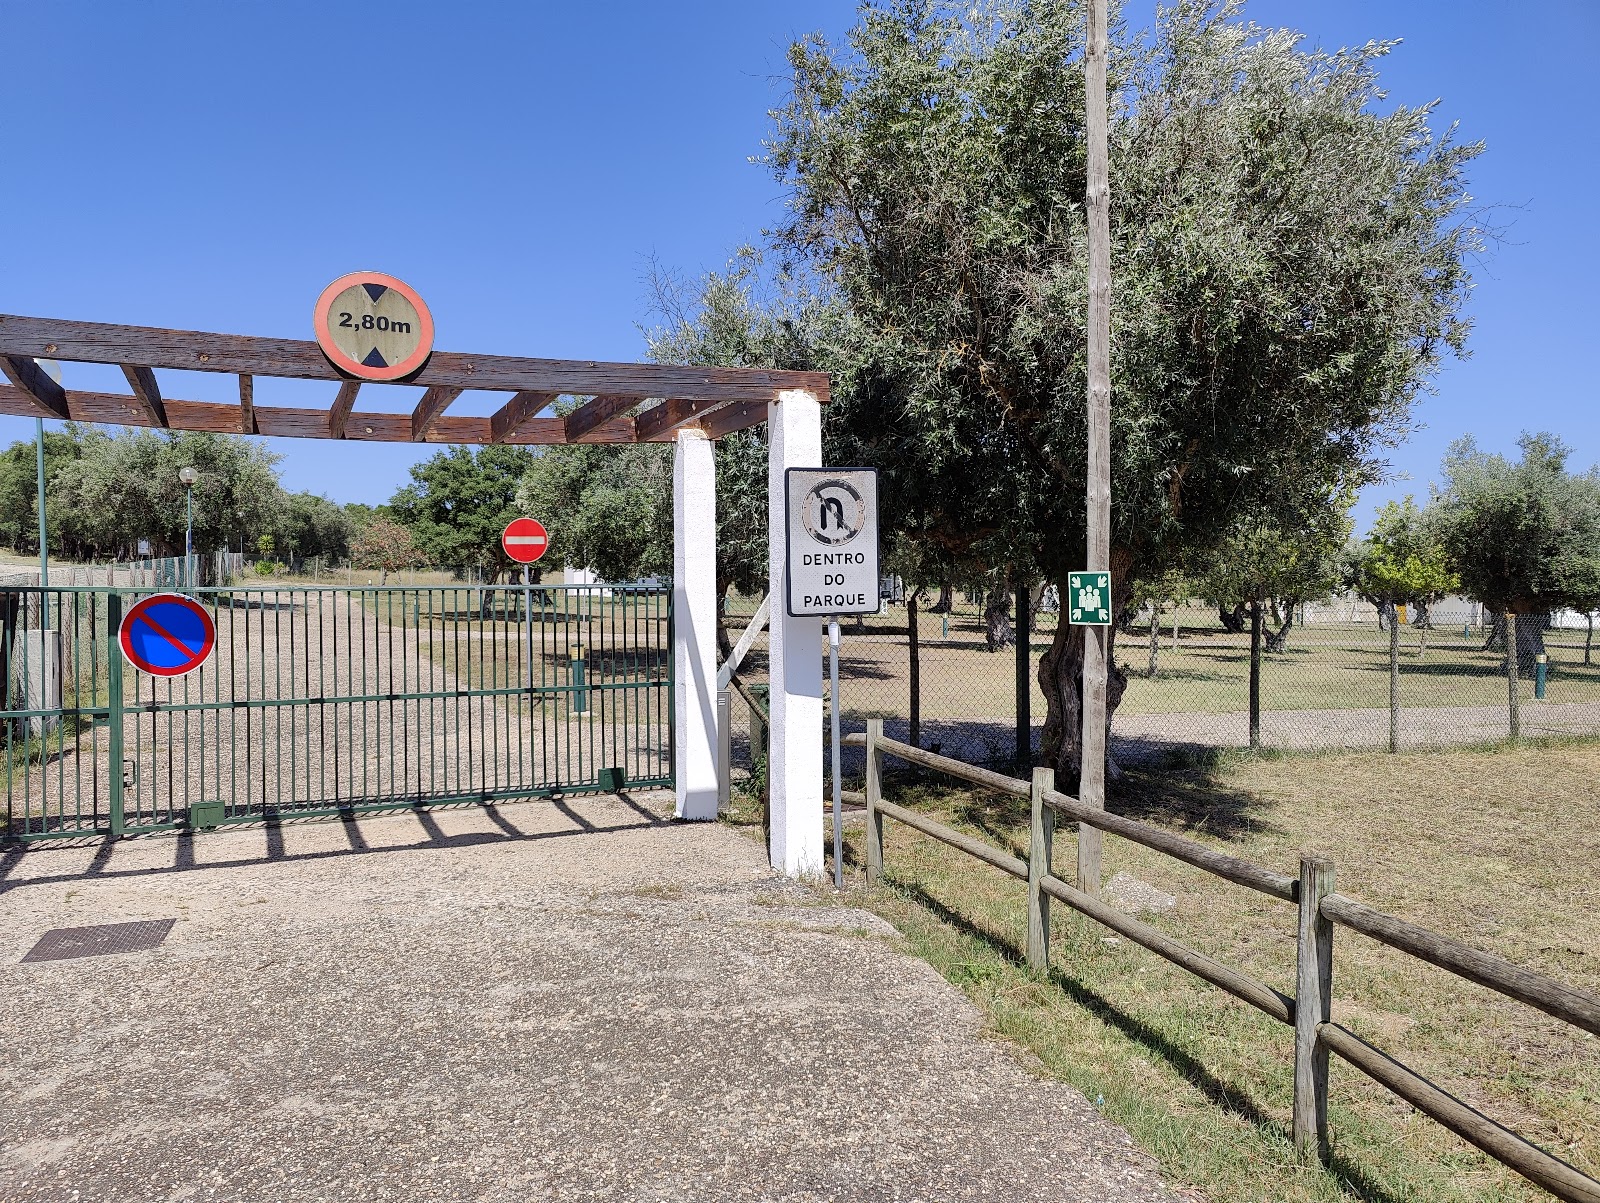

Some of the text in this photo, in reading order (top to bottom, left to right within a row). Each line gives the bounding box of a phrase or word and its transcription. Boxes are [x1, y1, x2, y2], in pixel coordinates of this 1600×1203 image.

[339, 312, 411, 334] 2,80m
[803, 552, 865, 566] DENTRO
[824, 573, 845, 586] DO
[804, 593, 866, 607] PARQUE
